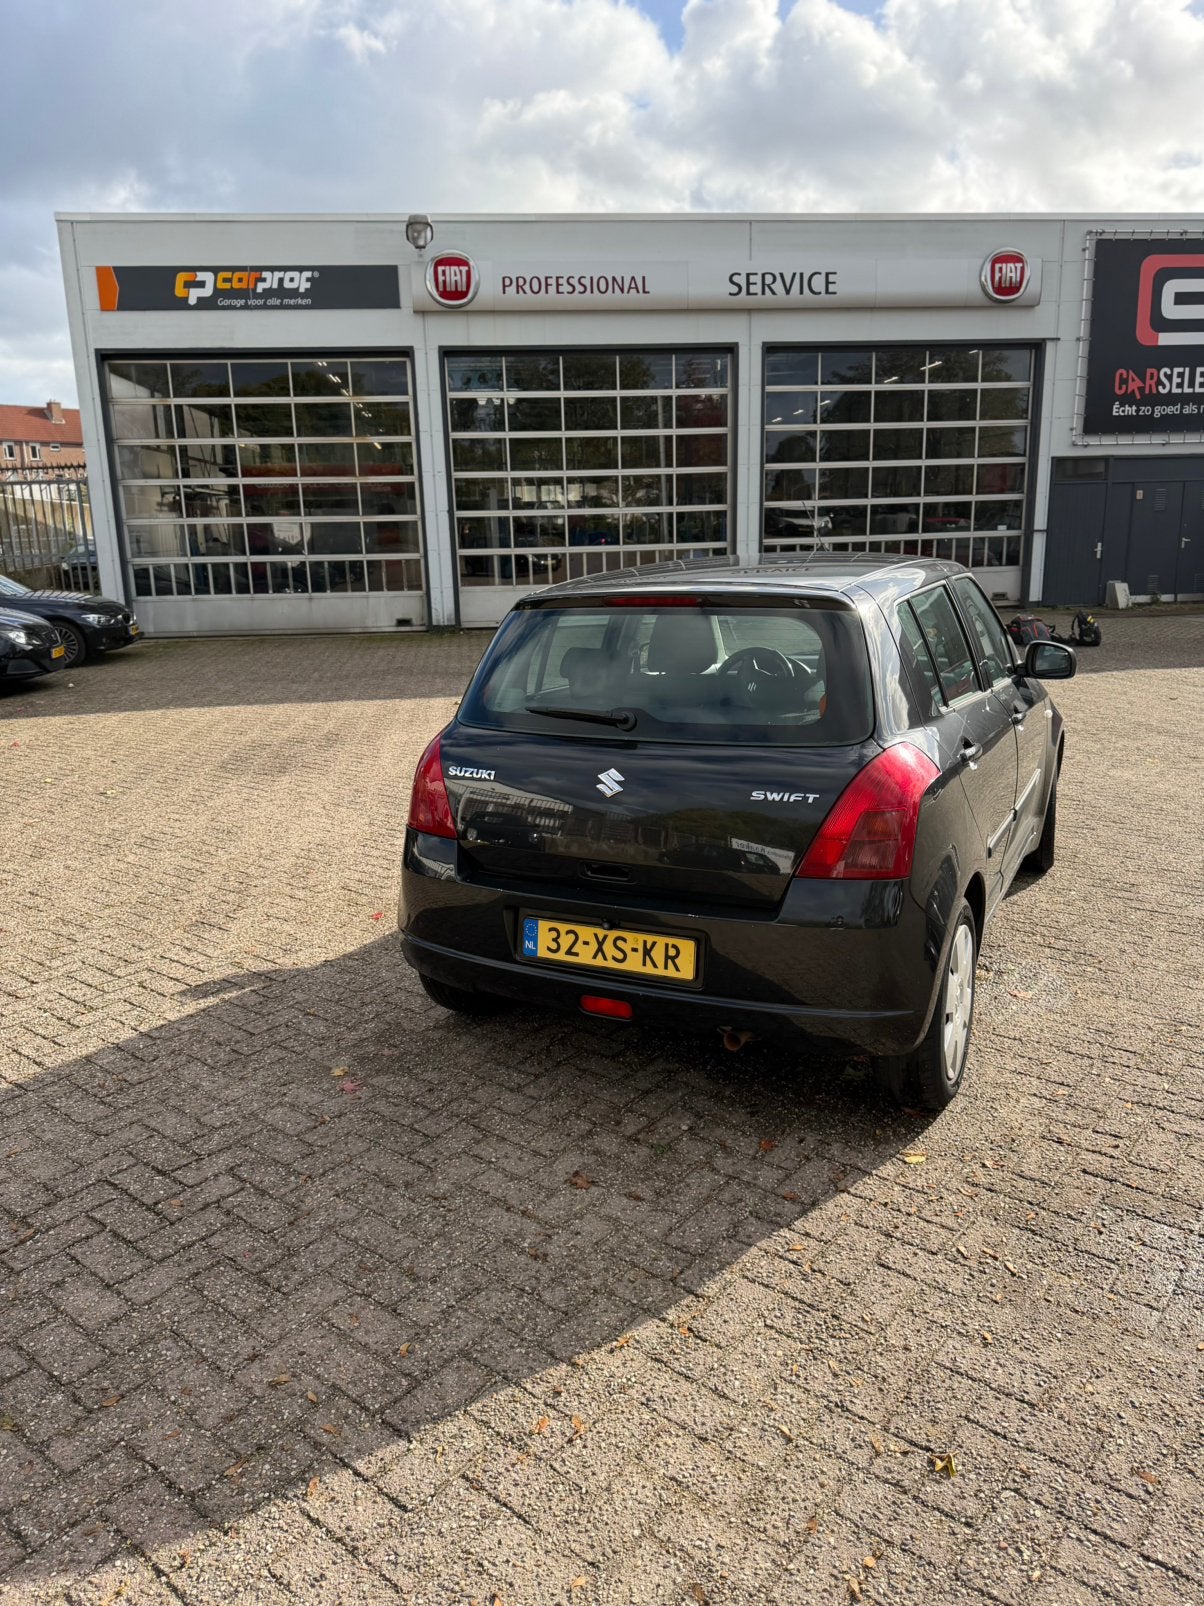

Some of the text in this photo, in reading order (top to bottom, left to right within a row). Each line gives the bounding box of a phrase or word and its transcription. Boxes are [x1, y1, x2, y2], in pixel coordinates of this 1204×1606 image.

[437, 265, 469, 292] FIAT
[501, 271, 838, 296] PROFESSIONAL SERVICE
[994, 262, 1023, 288] FIAT
[217, 297, 246, 308] Garage
[266, 297, 281, 306] alle
[283, 297, 312, 306] merken
[1112, 401, 1137, 416] Écht
[1138, 406, 1152, 415] zo
[1153, 402, 1181, 418] goed
[1182, 402, 1198, 414] als
[448, 765, 496, 780] SUZUKI
[750, 790, 820, 804] SWIFT
[525, 926, 681, 973] NL 32-XS-KR
